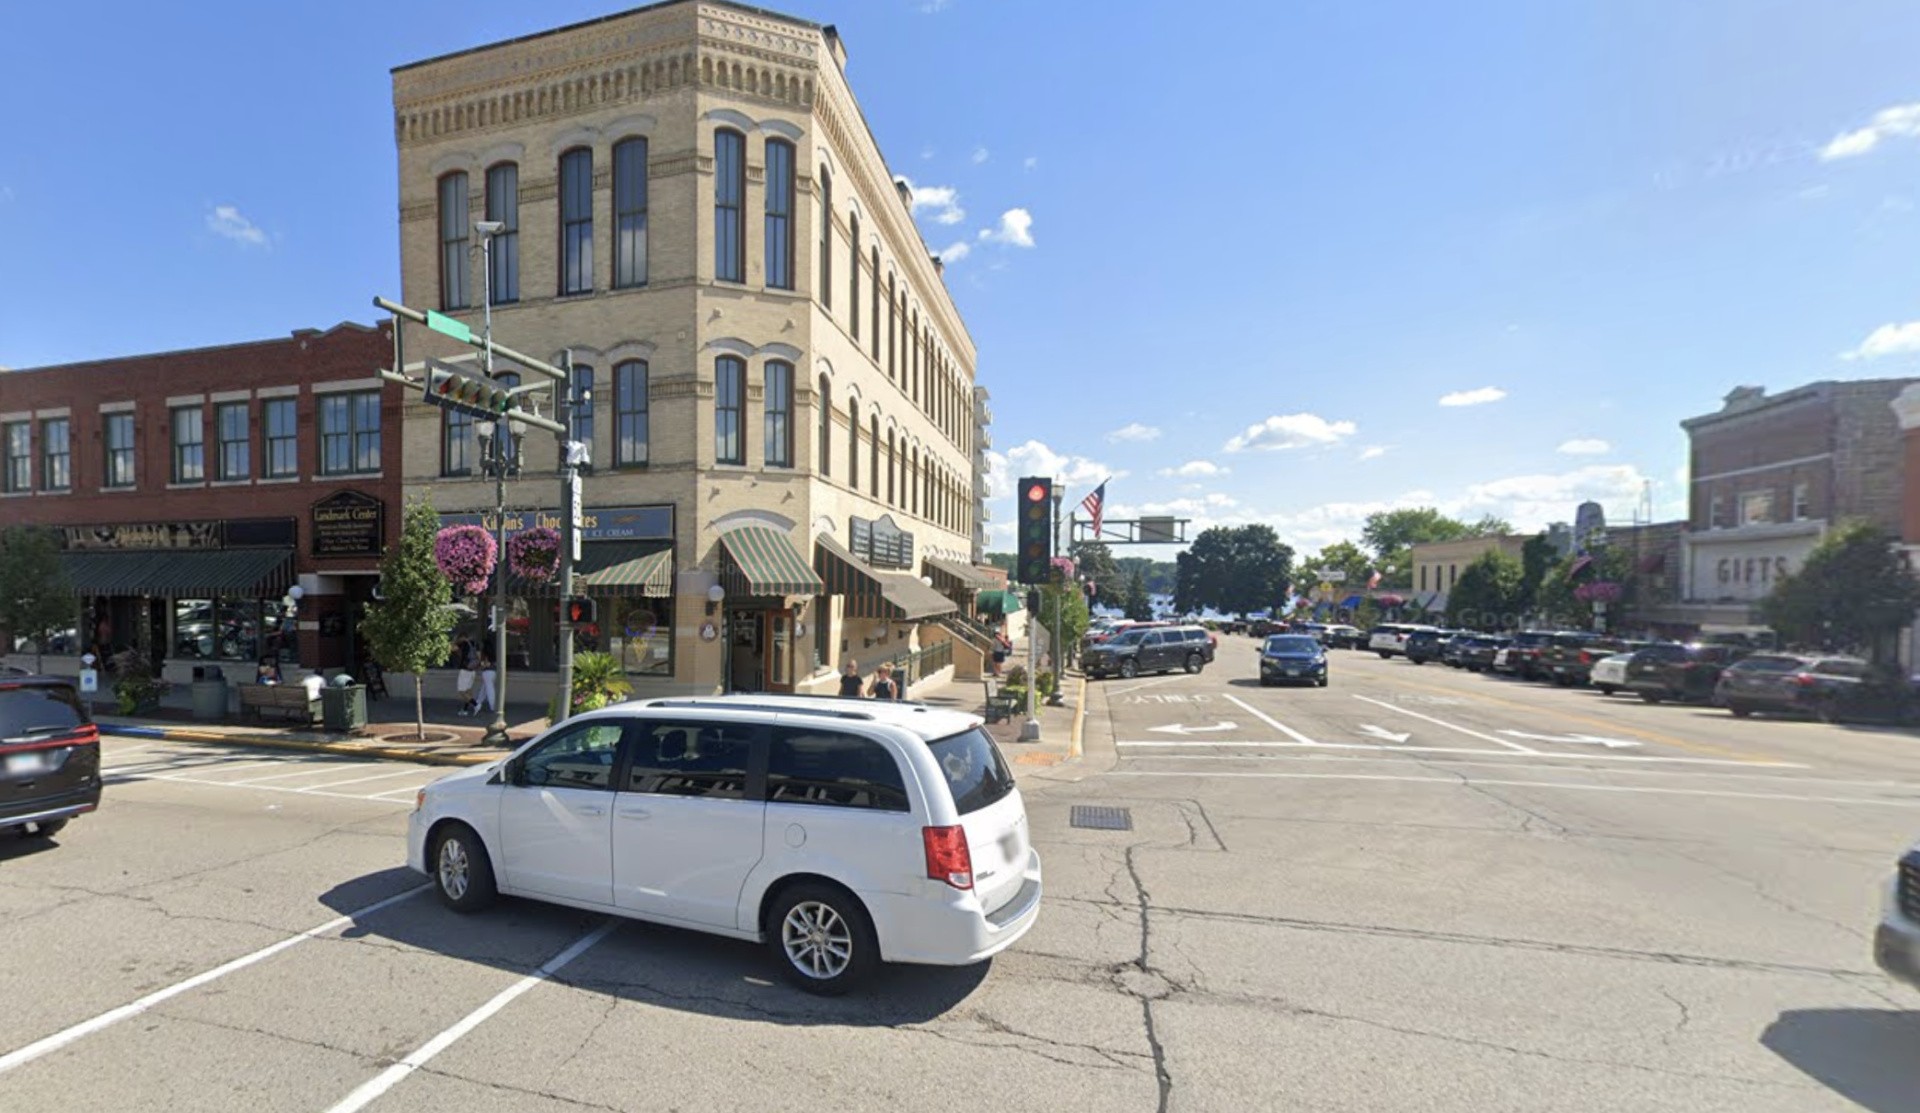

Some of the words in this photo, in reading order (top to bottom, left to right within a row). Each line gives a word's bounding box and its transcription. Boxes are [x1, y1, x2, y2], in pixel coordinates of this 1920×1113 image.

[314, 508, 350, 520] Landmark
[352, 507, 376, 520] Center
[482, 514, 525, 530] Kilin's
[535, 512, 597, 529] Choctes
[1717, 556, 1787, 584] GIFTS
